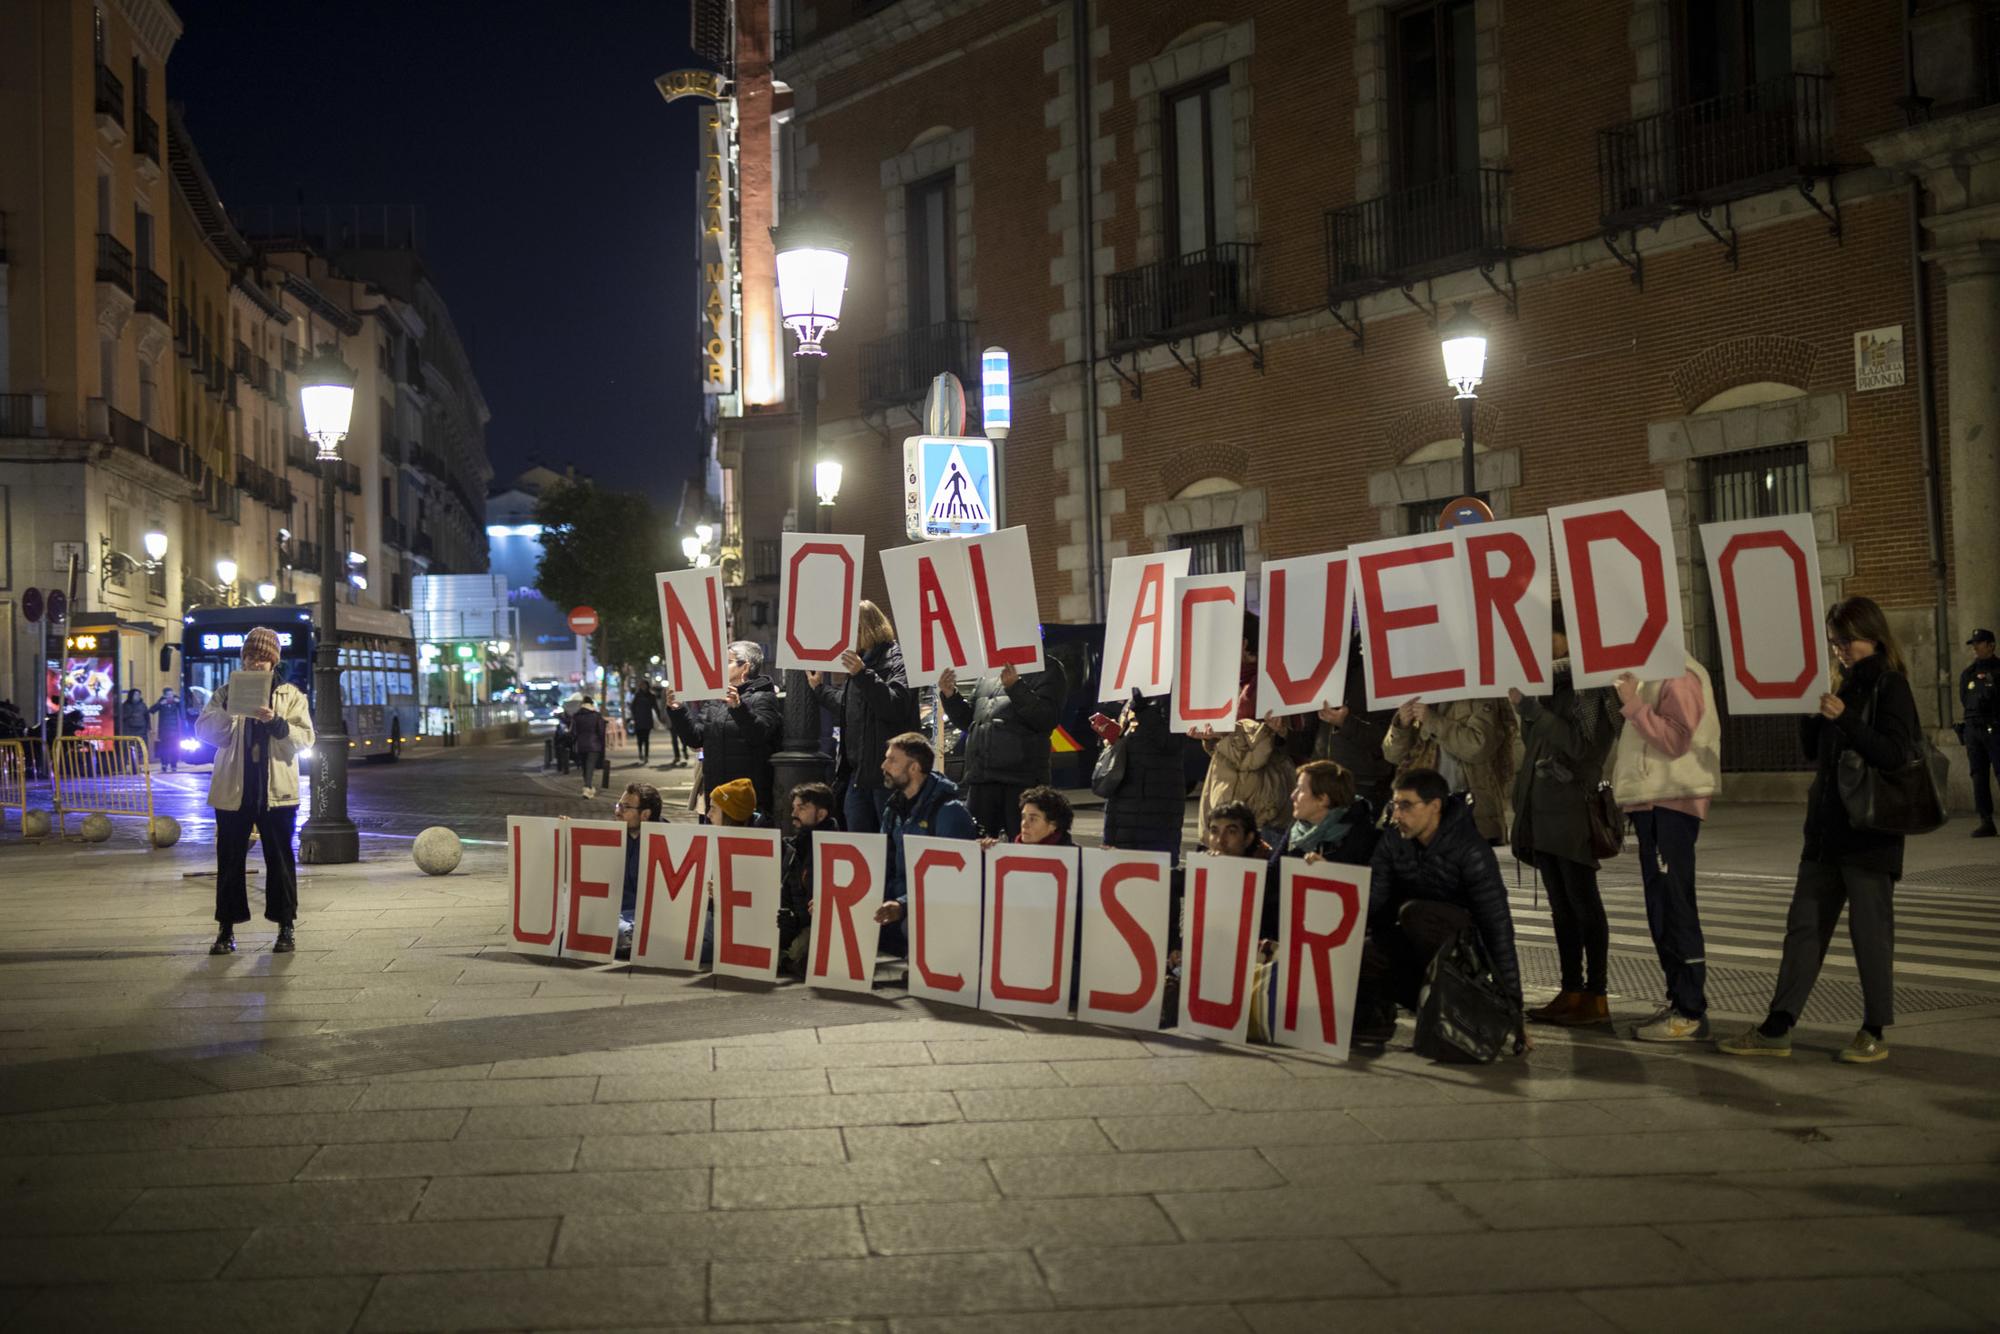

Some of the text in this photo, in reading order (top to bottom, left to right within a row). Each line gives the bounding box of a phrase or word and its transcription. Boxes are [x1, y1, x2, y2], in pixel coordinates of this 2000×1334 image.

[662, 71, 722, 97] HOTEL
[706, 113, 725, 384] PLAZA MAYOR
[1858, 365, 1885, 377] PLAZA
[1858, 372, 1904, 389] PROVINCIA
[662, 509, 1819, 721] NO AL ACUERDO
